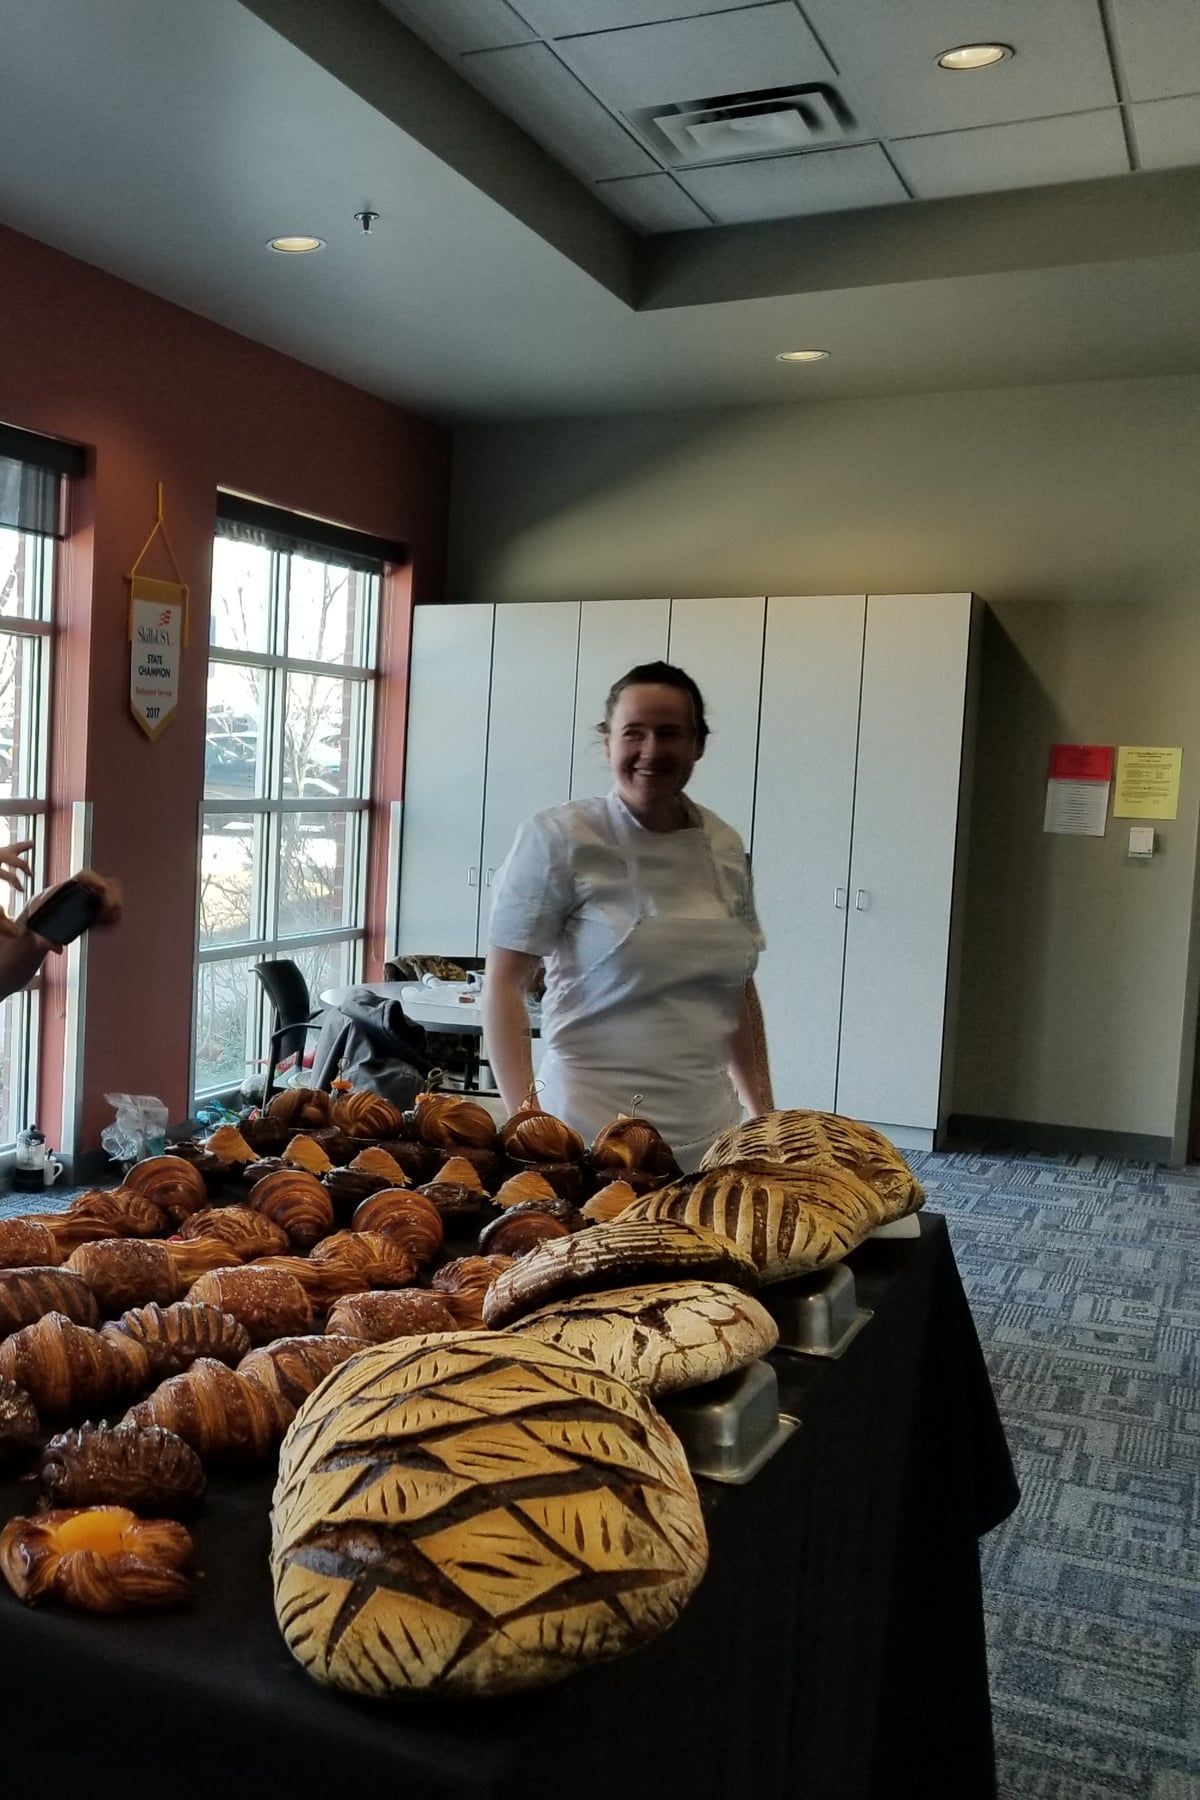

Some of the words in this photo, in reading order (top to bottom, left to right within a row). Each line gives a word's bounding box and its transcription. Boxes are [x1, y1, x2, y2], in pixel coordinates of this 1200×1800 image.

[146, 653, 163, 665] STATE
[137, 665, 171, 679] CHAMPION
[146, 706, 160, 719] 2017
